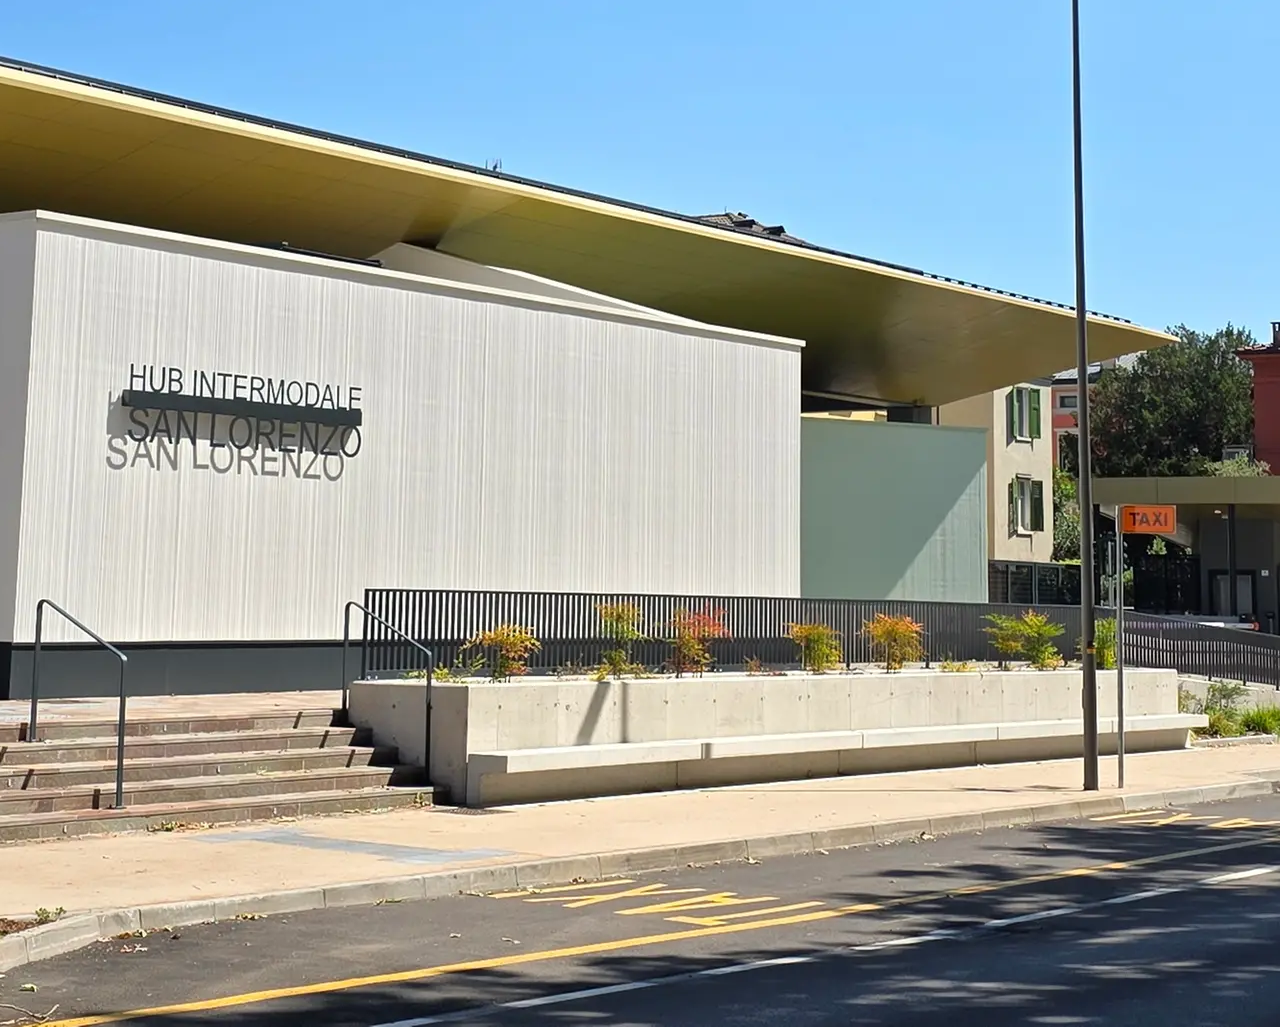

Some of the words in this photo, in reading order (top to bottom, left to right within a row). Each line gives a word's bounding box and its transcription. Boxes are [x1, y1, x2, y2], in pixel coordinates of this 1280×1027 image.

[130, 363, 183, 394] HUB
[193, 369, 363, 411] INTERMODALE
[127, 408, 197, 446] SAN
[210, 412, 363, 458] LORENZO
[1129, 512, 1168, 526] TAXI
[485, 878, 826, 926] TAXI
